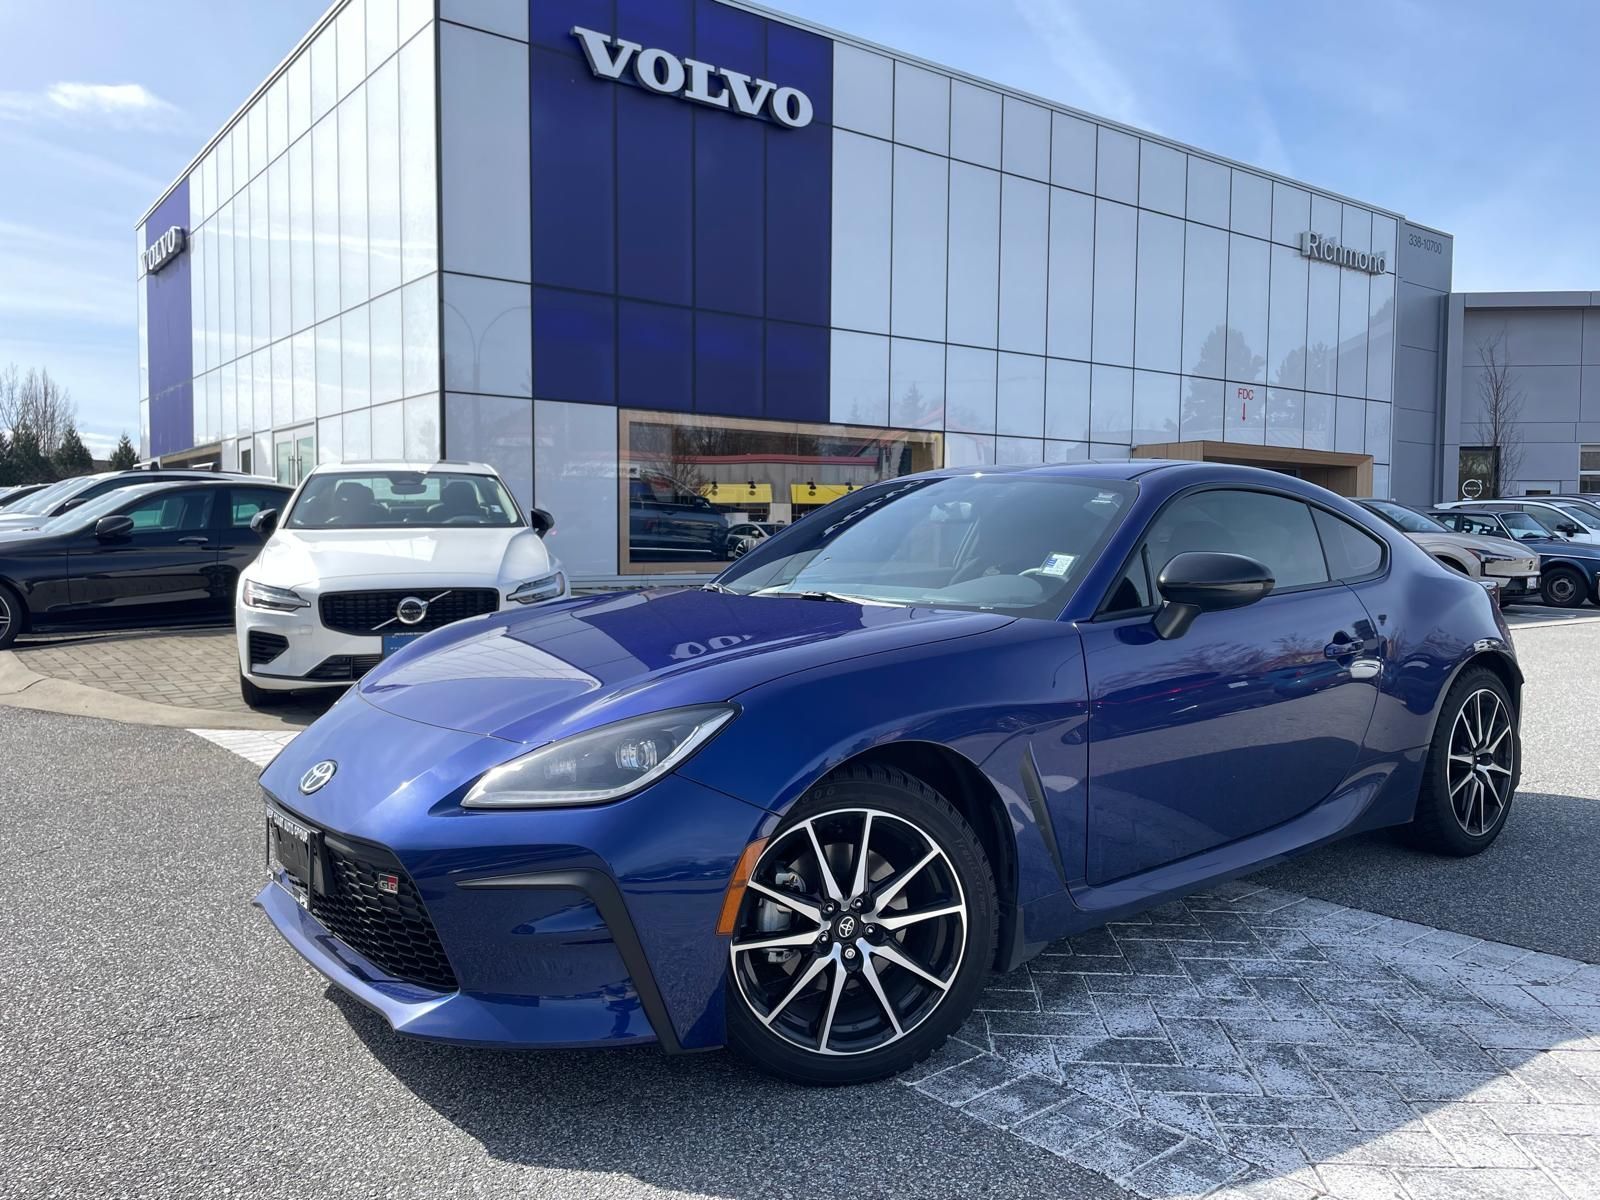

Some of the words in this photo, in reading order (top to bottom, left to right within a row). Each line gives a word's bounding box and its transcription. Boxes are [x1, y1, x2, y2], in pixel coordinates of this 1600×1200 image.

[570, 25, 814, 128] VOLVO
[141, 226, 177, 274] VOLVO
[1305, 231, 1386, 274] Richmond
[1408, 233, 1442, 255] 338-10700
[1237, 388, 1254, 400] FDC
[379, 880, 397, 891] GR
